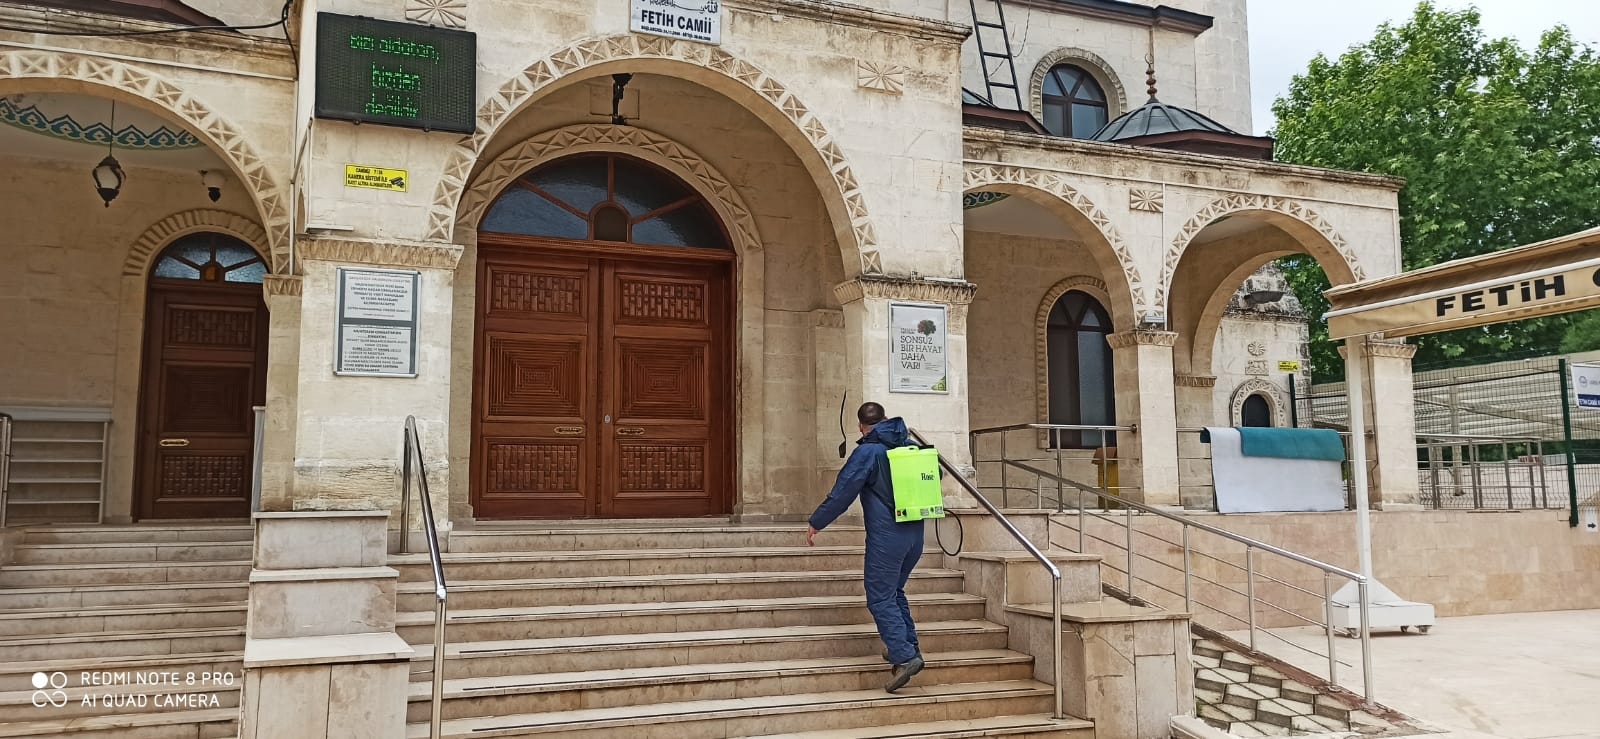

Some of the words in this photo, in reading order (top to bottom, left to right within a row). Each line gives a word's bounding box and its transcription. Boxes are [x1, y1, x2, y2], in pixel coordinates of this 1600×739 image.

[641, 9, 674, 28] FETİH
[677, 16, 712, 34] CAMİİ
[1436, 274, 1566, 317] FETİH
[900, 335, 933, 345] SONSUZ
[915, 345, 942, 354] HAYAT
[901, 352, 926, 361] DAHA
